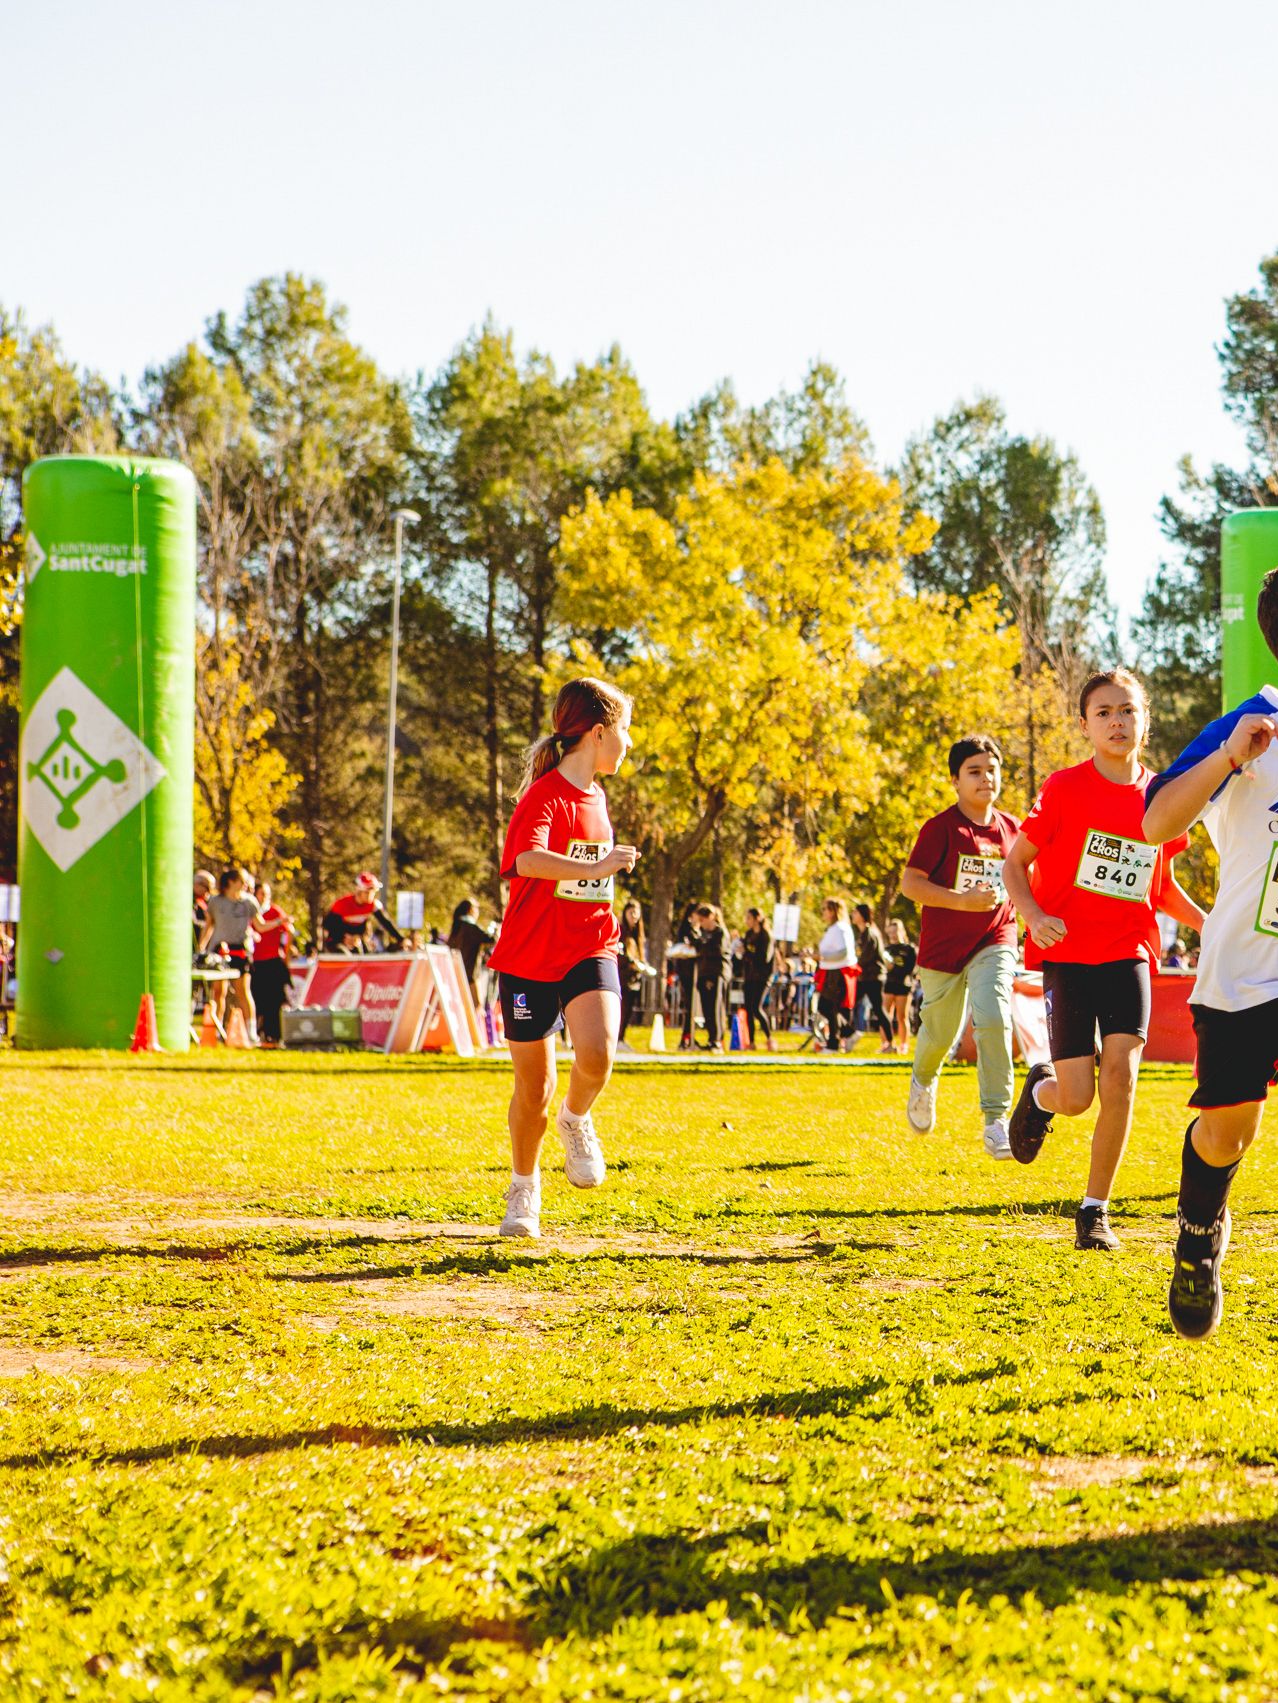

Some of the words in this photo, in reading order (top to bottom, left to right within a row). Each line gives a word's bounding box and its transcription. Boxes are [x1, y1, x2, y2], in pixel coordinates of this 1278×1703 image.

[49, 555, 148, 577] SantCugat
[1090, 844, 1119, 858] CROS
[1095, 865, 1136, 887] 840
